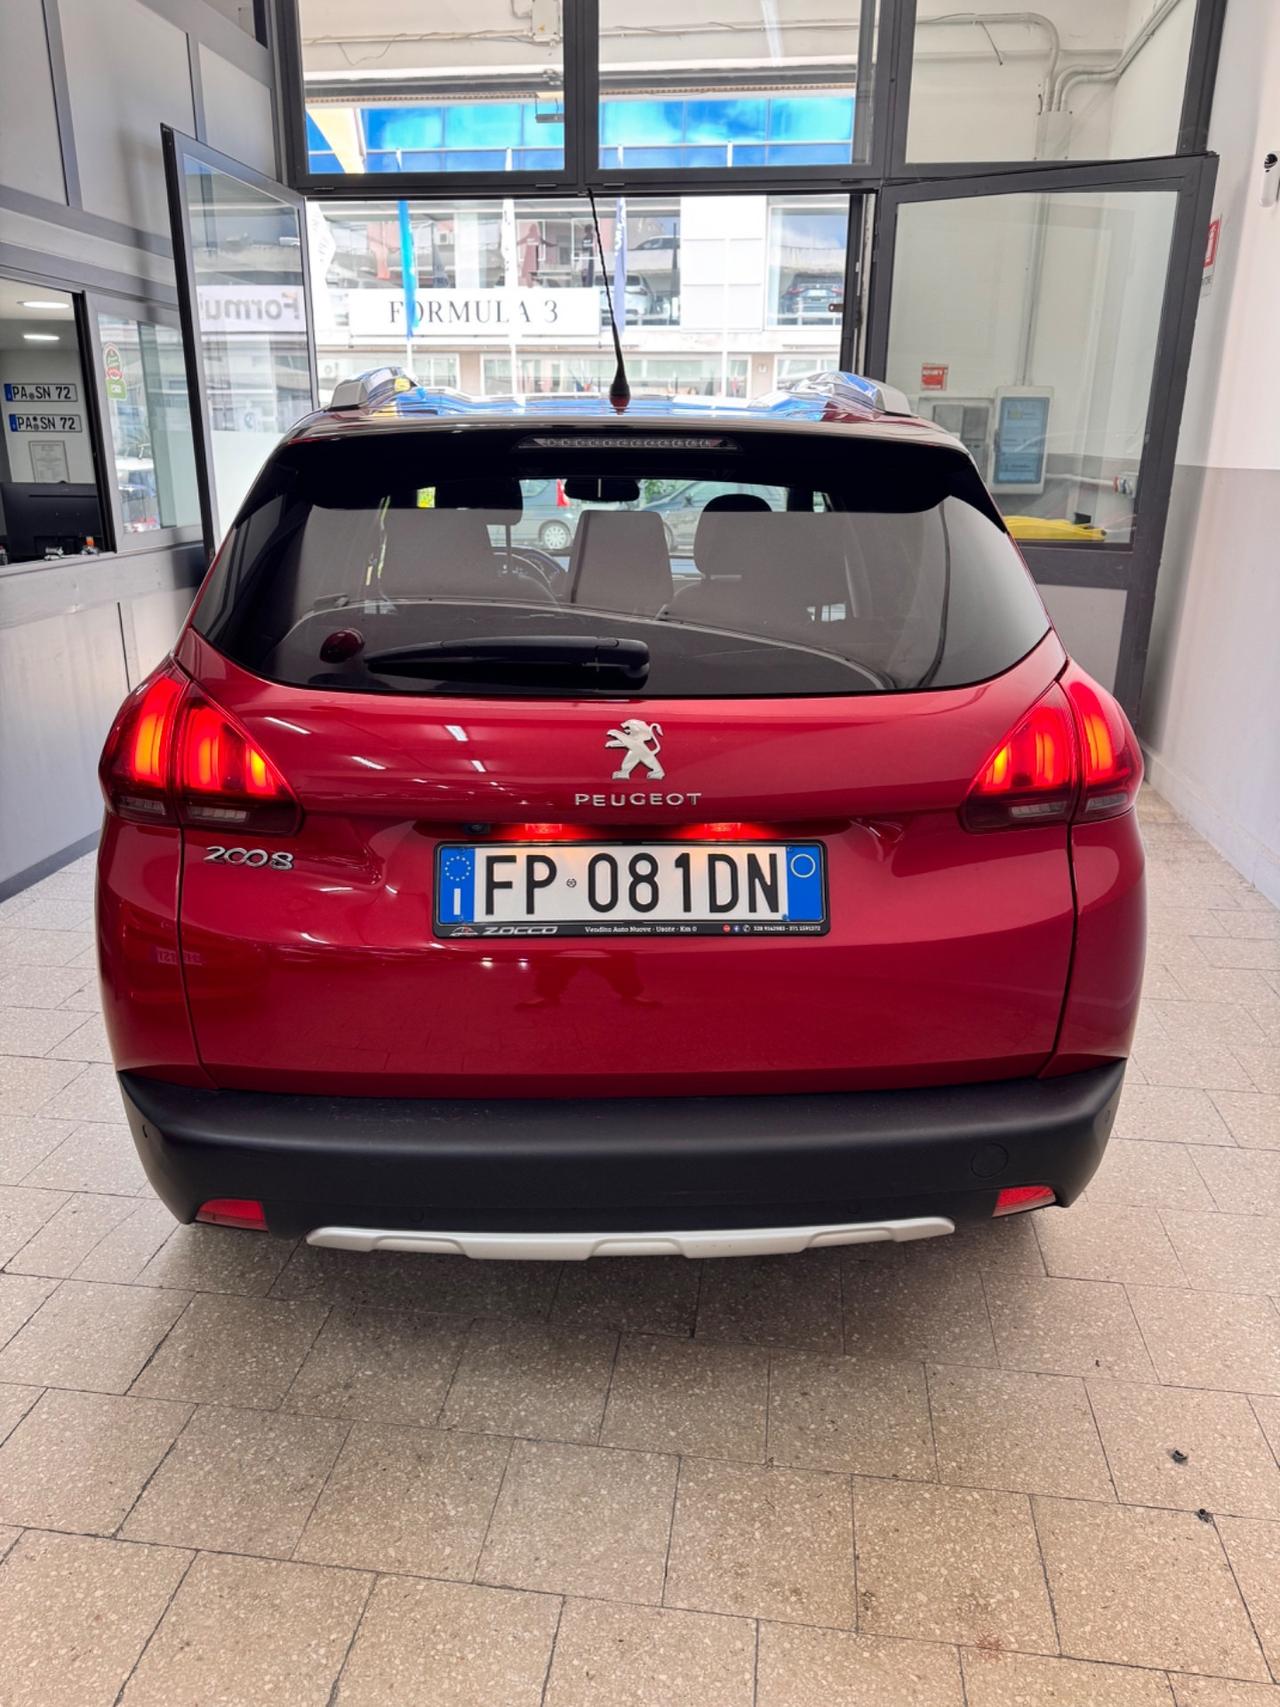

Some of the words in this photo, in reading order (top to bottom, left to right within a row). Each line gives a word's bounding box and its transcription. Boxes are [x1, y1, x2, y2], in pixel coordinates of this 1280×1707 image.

[544, 300, 559, 324] 3
[12, 386, 28, 399] PA
[35, 386, 52, 399] SN
[55, 386, 72, 399] 72
[40, 417, 56, 430] SN
[59, 417, 76, 430] 72
[574, 793, 702, 806] PEUGEOT
[203, 846, 294, 870] 2008
[485, 854, 558, 916] FP
[587, 852, 780, 914] 081DN
[482, 926, 559, 936] ZOCCO
